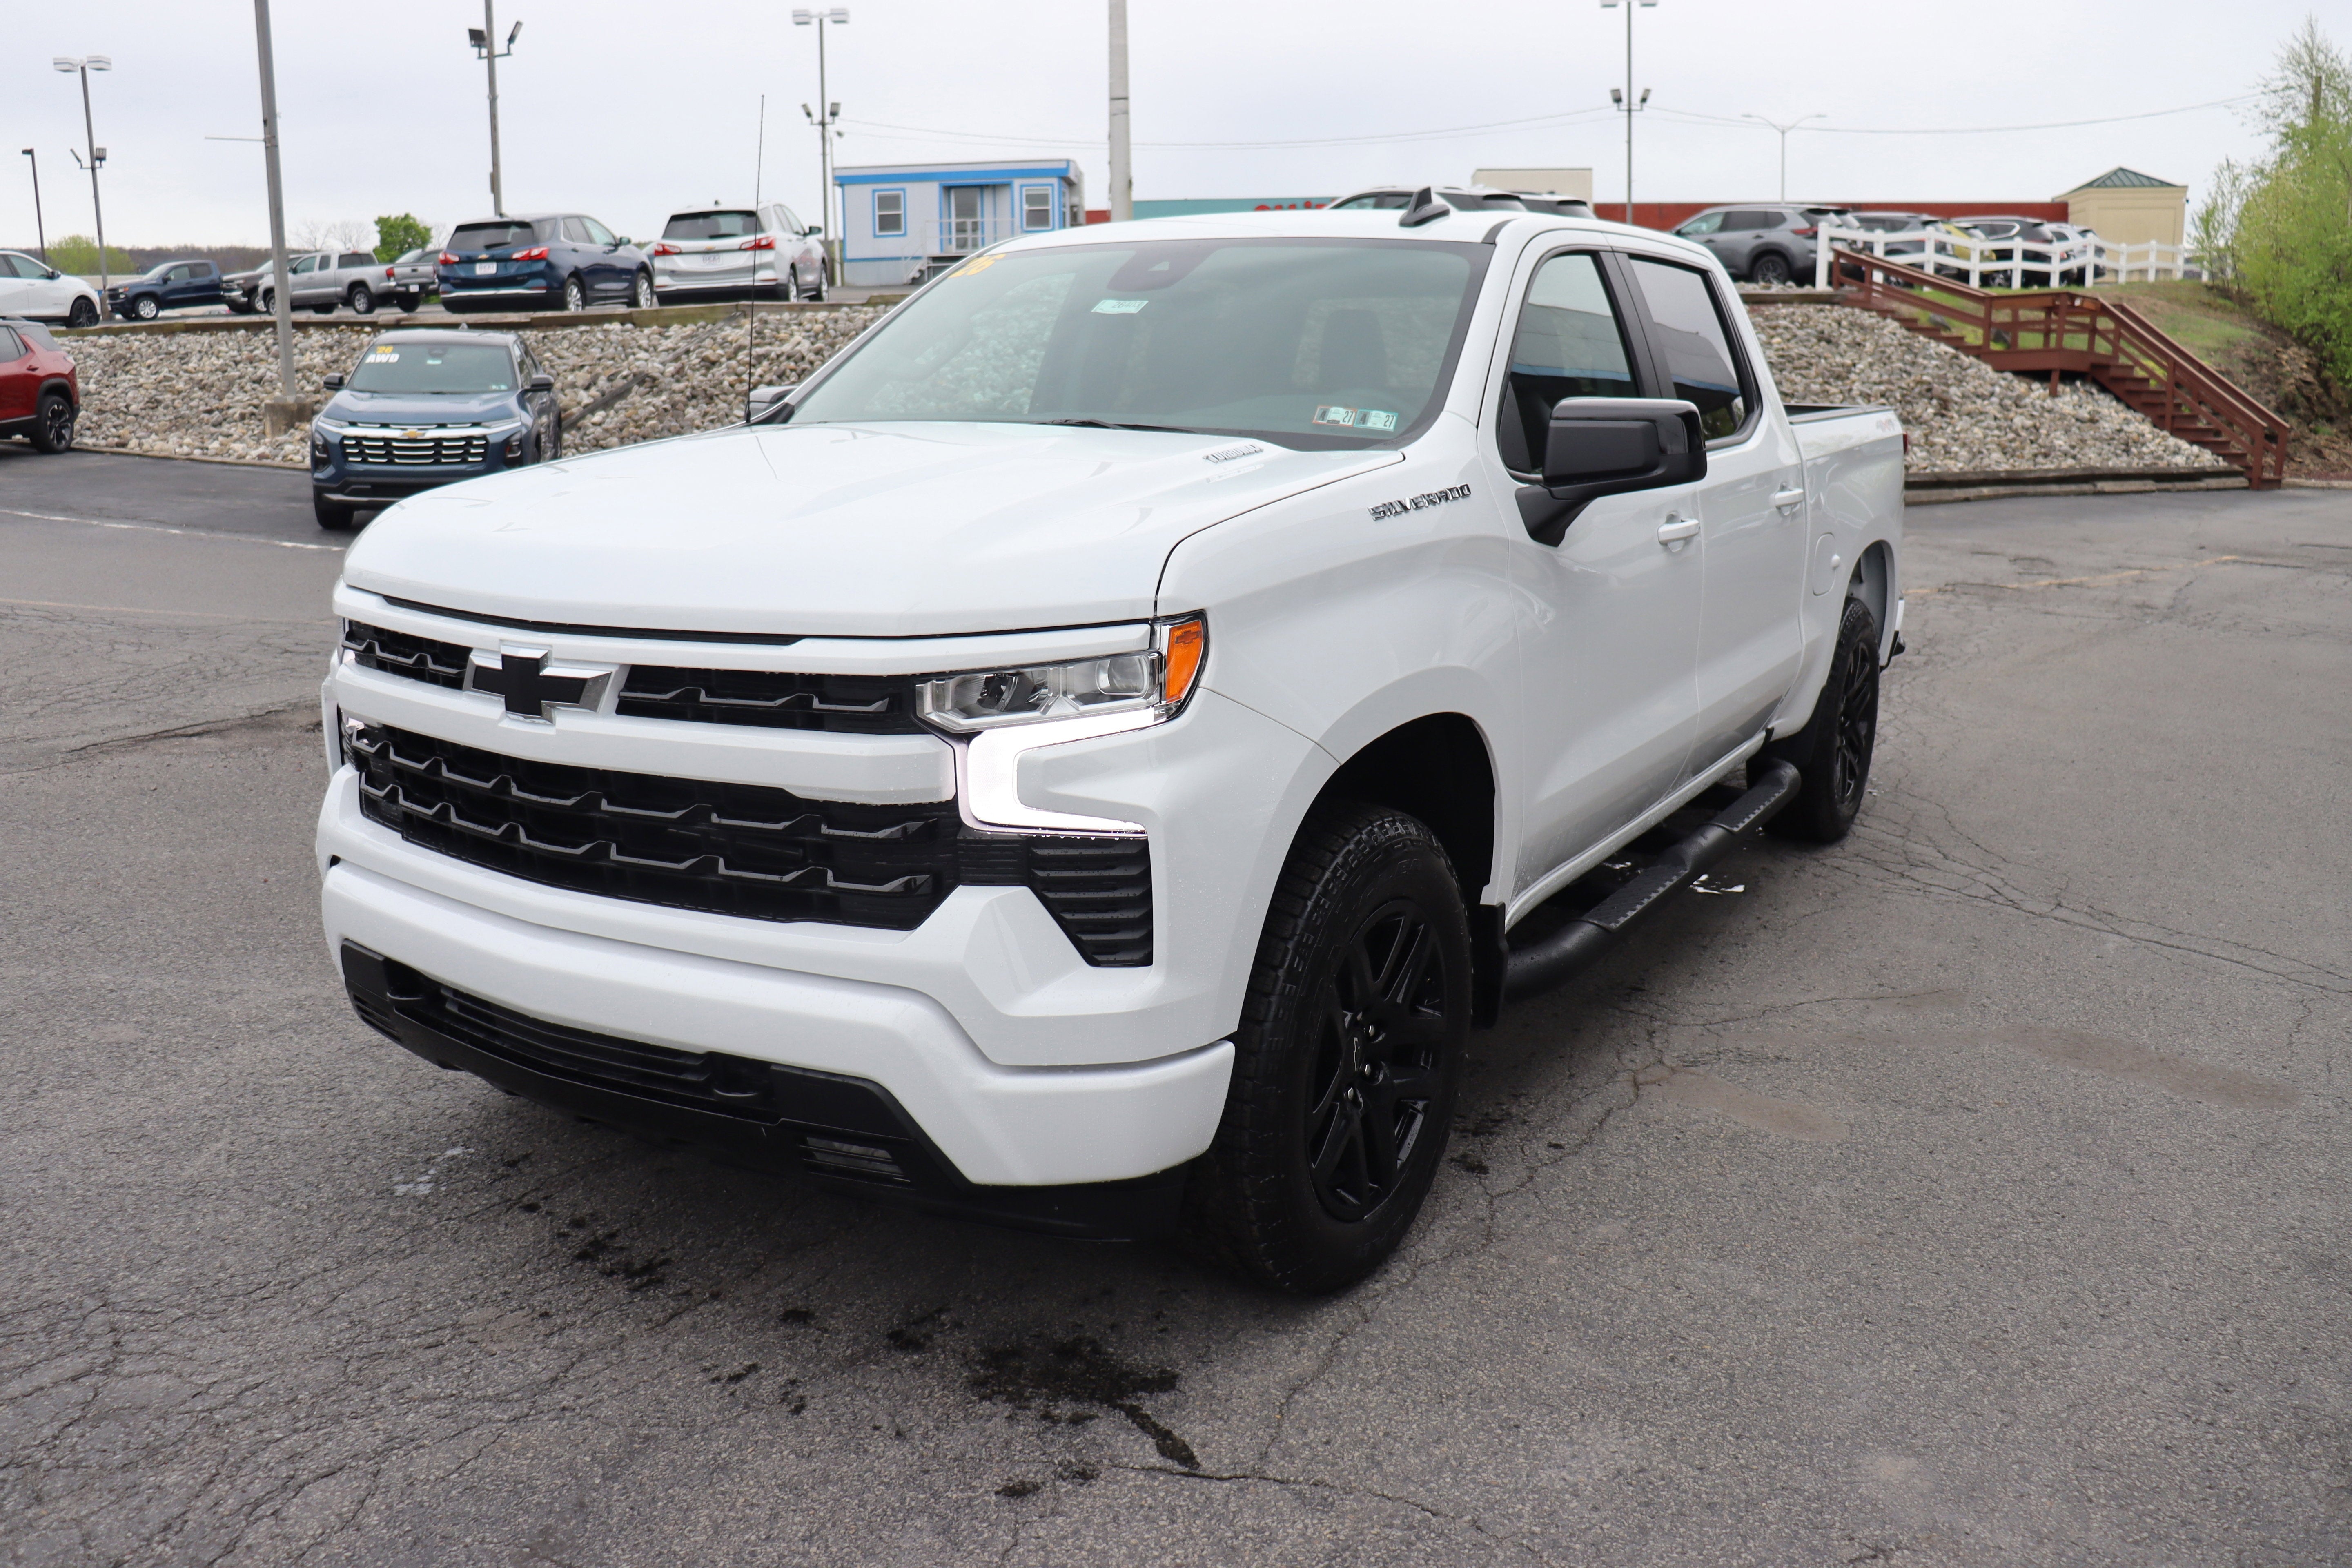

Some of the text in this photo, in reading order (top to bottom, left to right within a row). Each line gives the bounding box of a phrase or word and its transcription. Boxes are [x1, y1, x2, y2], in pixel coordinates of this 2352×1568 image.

[365, 354, 400, 363] AWD
[1342, 410, 1354, 424] 27
[1383, 414, 1395, 428] 27
[1367, 483, 1471, 521] SILVERADO
